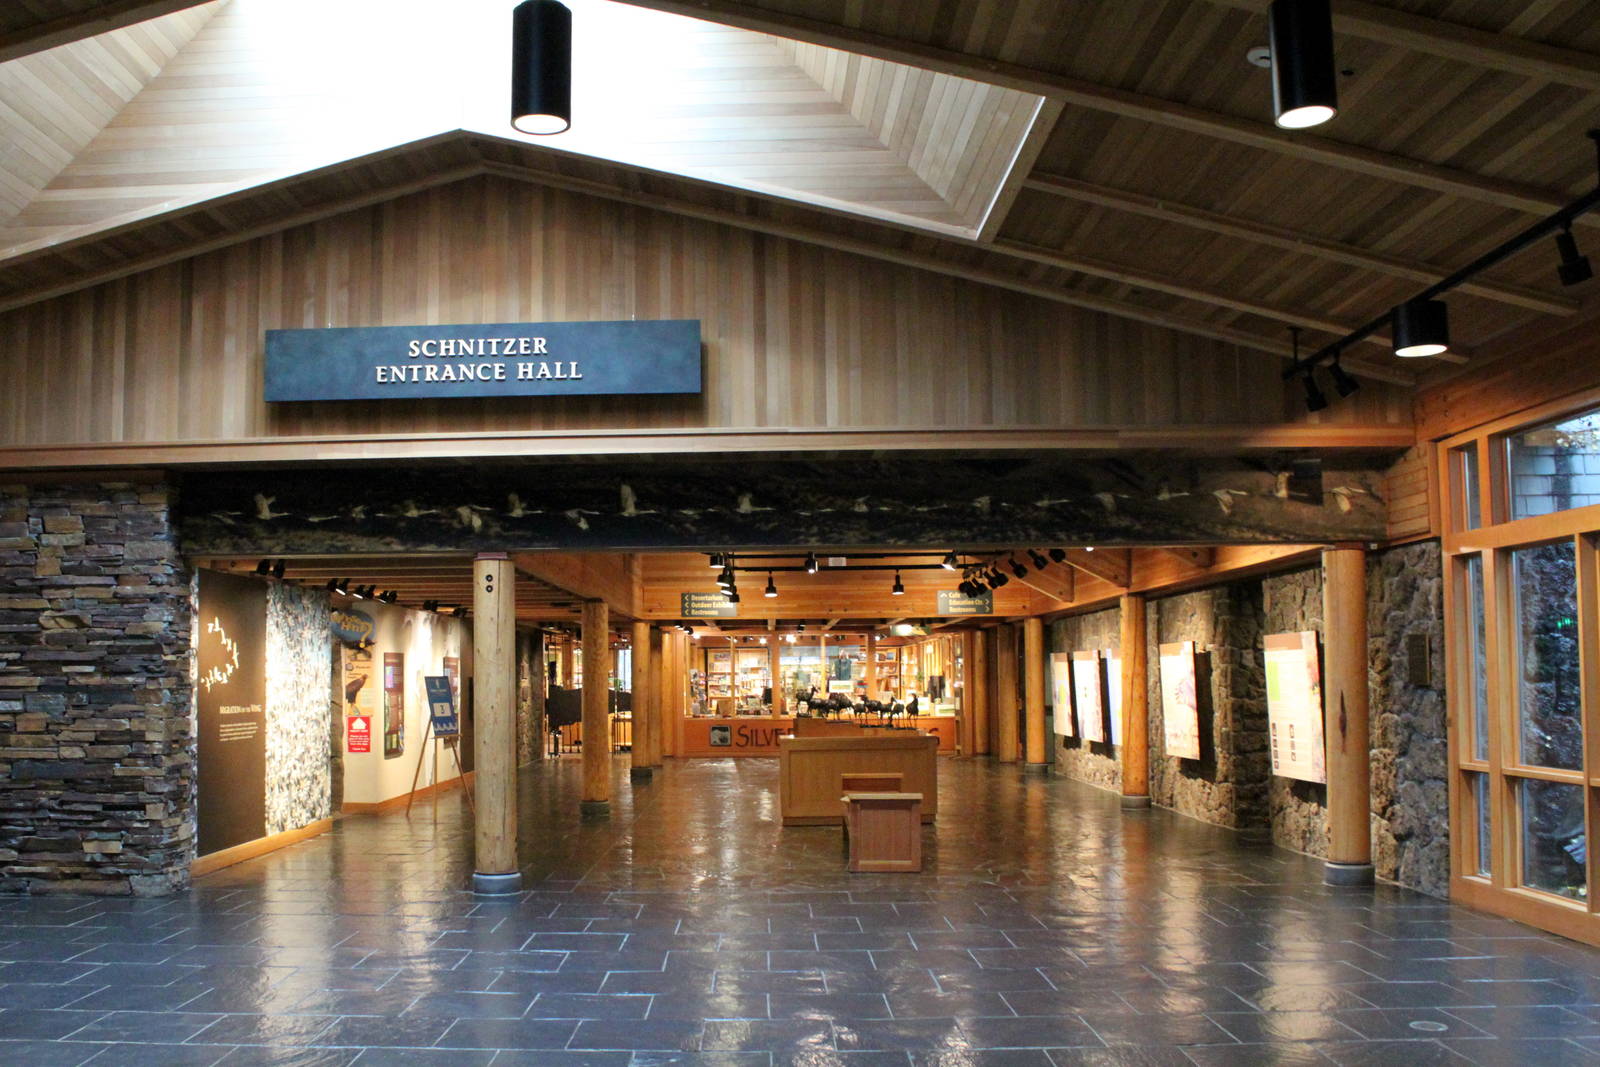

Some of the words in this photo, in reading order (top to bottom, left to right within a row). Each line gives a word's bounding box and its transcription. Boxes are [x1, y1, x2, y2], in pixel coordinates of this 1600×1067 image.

[408, 337, 549, 358] SCHNITZER
[375, 363, 506, 383] ENTRANCE
[517, 361, 583, 380] HALL
